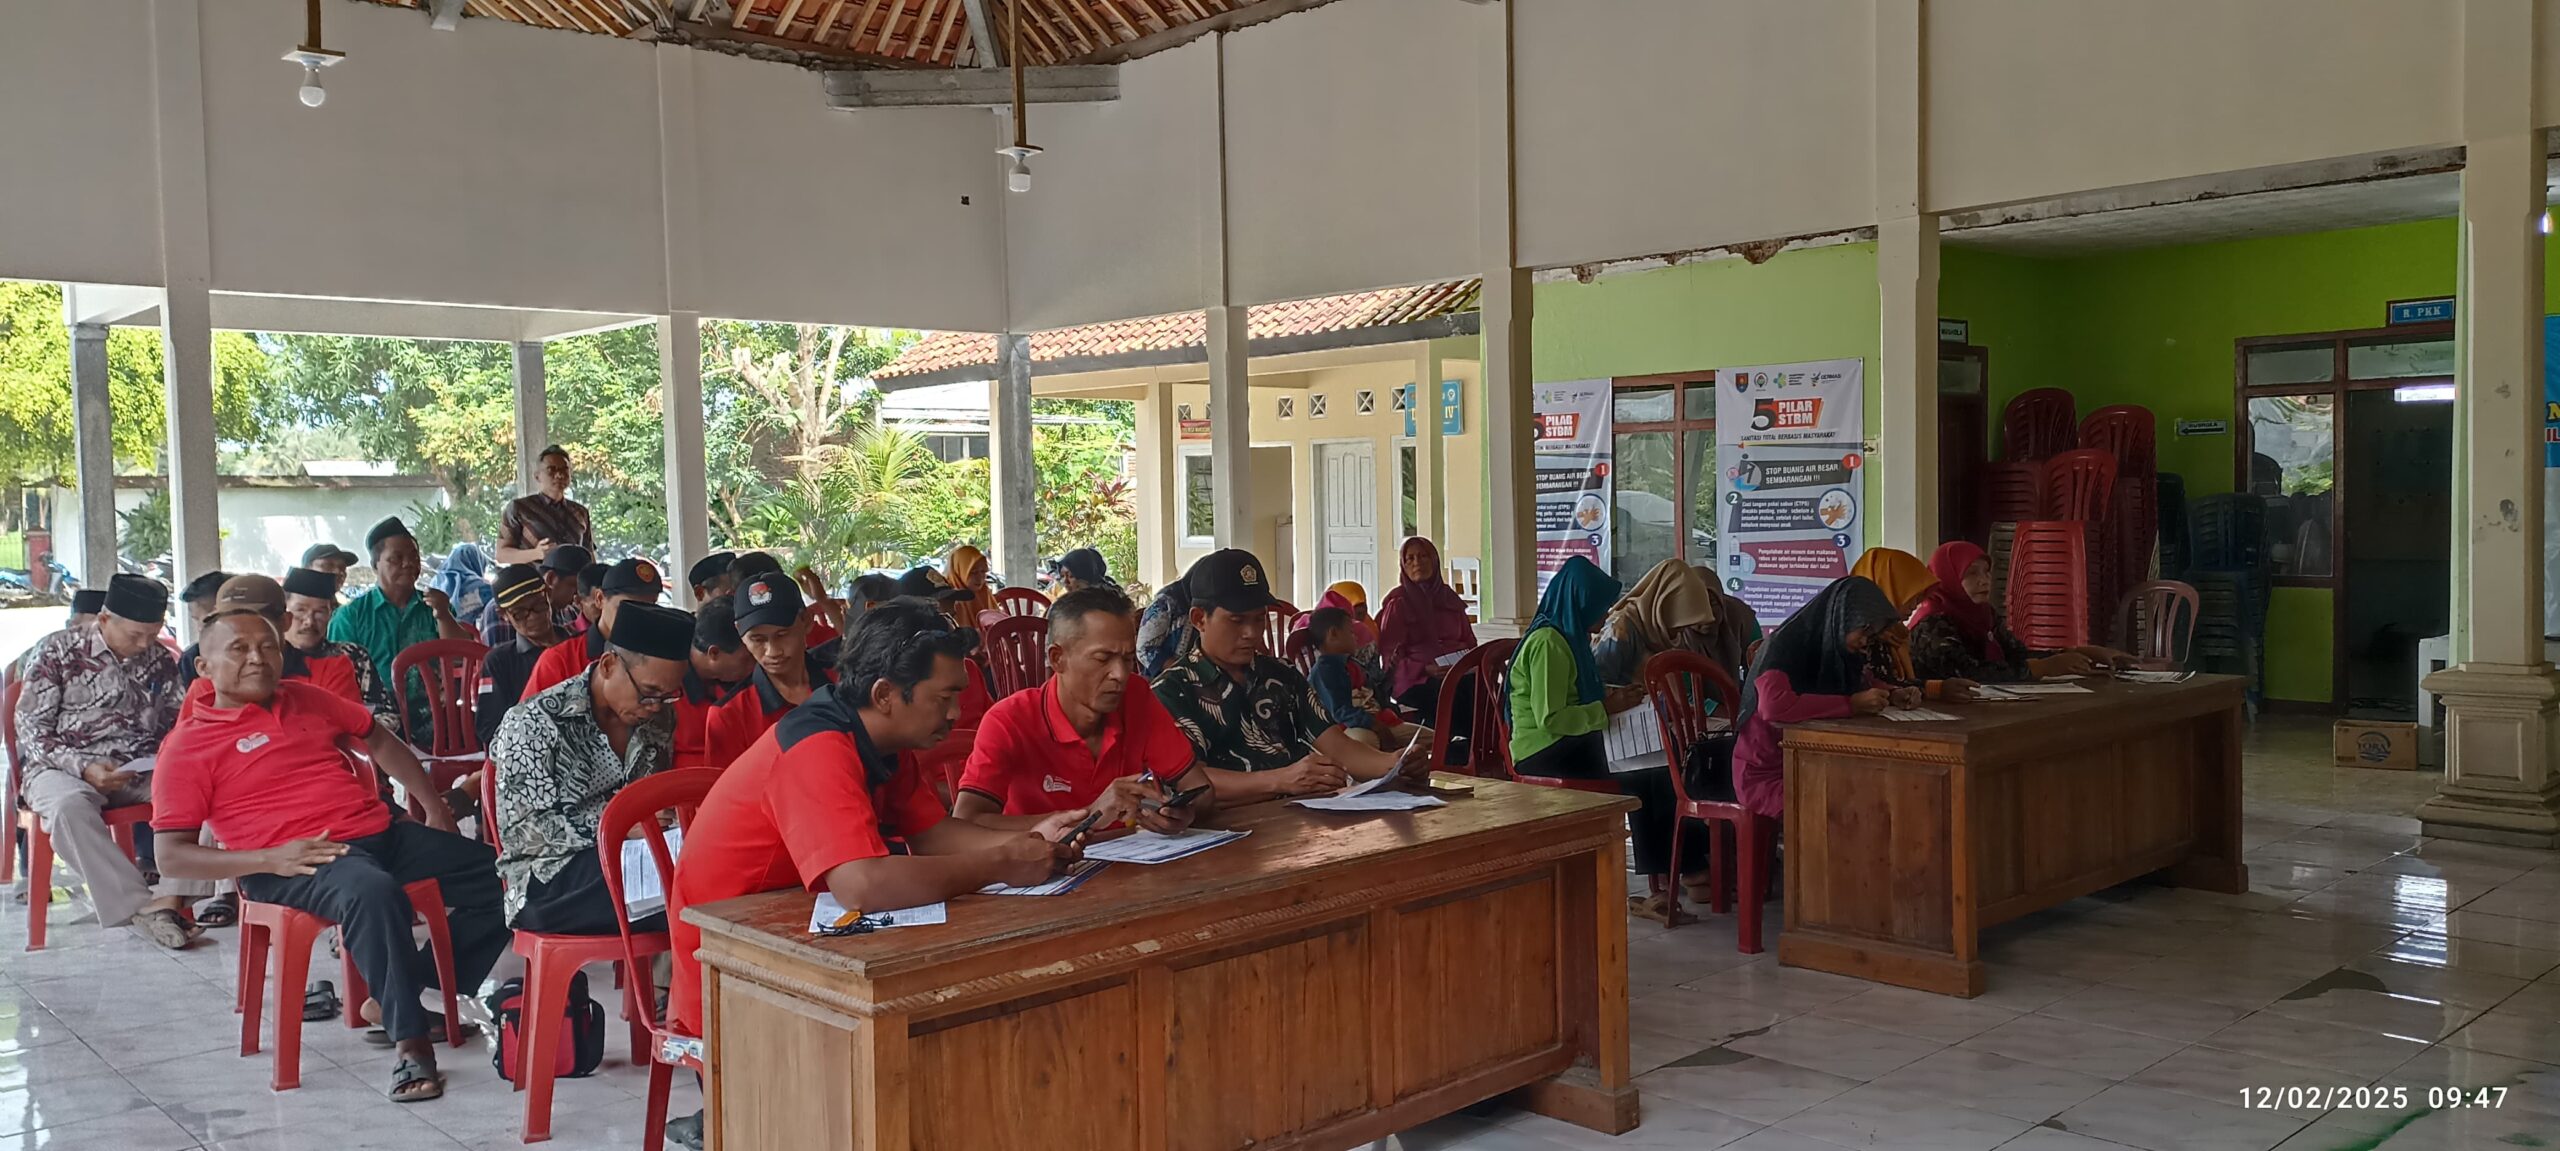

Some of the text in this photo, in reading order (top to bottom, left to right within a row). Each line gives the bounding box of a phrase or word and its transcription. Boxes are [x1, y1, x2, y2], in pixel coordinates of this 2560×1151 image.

[2417, 306, 2441, 317] PKK
[1778, 400, 1813, 413] PILAR
[1751, 398, 1776, 431] 5
[1778, 412, 1813, 425] STBM
[1545, 415, 1573, 426] PILAR
[1545, 426, 1573, 437] STBM
[1765, 467, 1781, 475] STOP
[1783, 466, 1804, 474] BUANG
[1817, 464, 1839, 472] BESAR
[1549, 473, 1566, 481] BUANG
[1765, 475, 1812, 484] SEMBARANGAN
[1730, 492, 1739, 504] 2
[1591, 535, 1599, 546] 3
[1836, 535, 1846, 547] 3
[1731, 579, 1740, 591] 4
